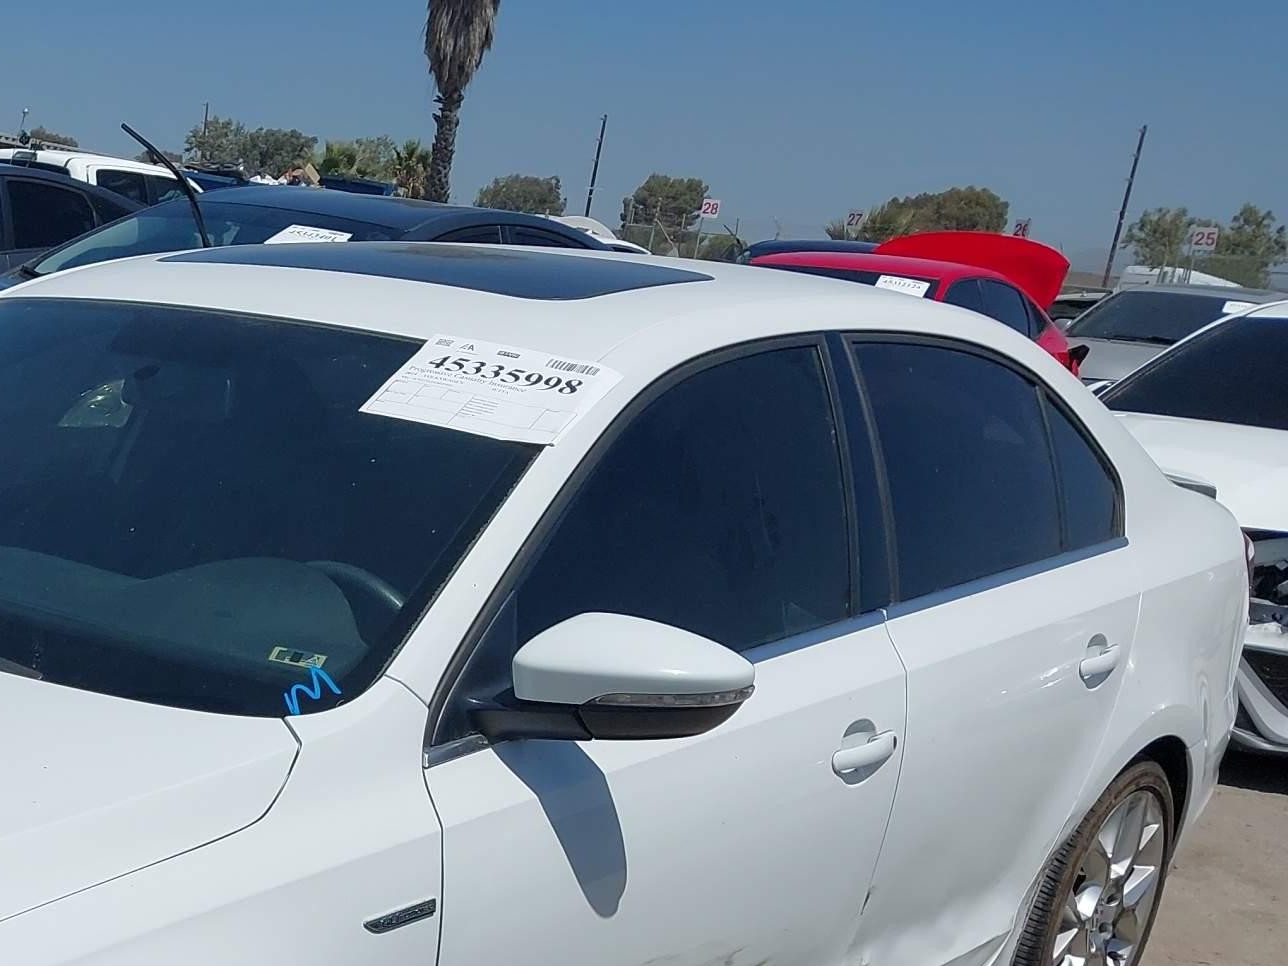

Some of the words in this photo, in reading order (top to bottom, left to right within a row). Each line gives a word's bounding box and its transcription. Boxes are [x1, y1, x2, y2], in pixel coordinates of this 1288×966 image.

[702, 202, 719, 215] 28
[847, 213, 864, 226] 27
[1193, 231, 1216, 246] 25
[427, 355, 584, 395] 45335998
